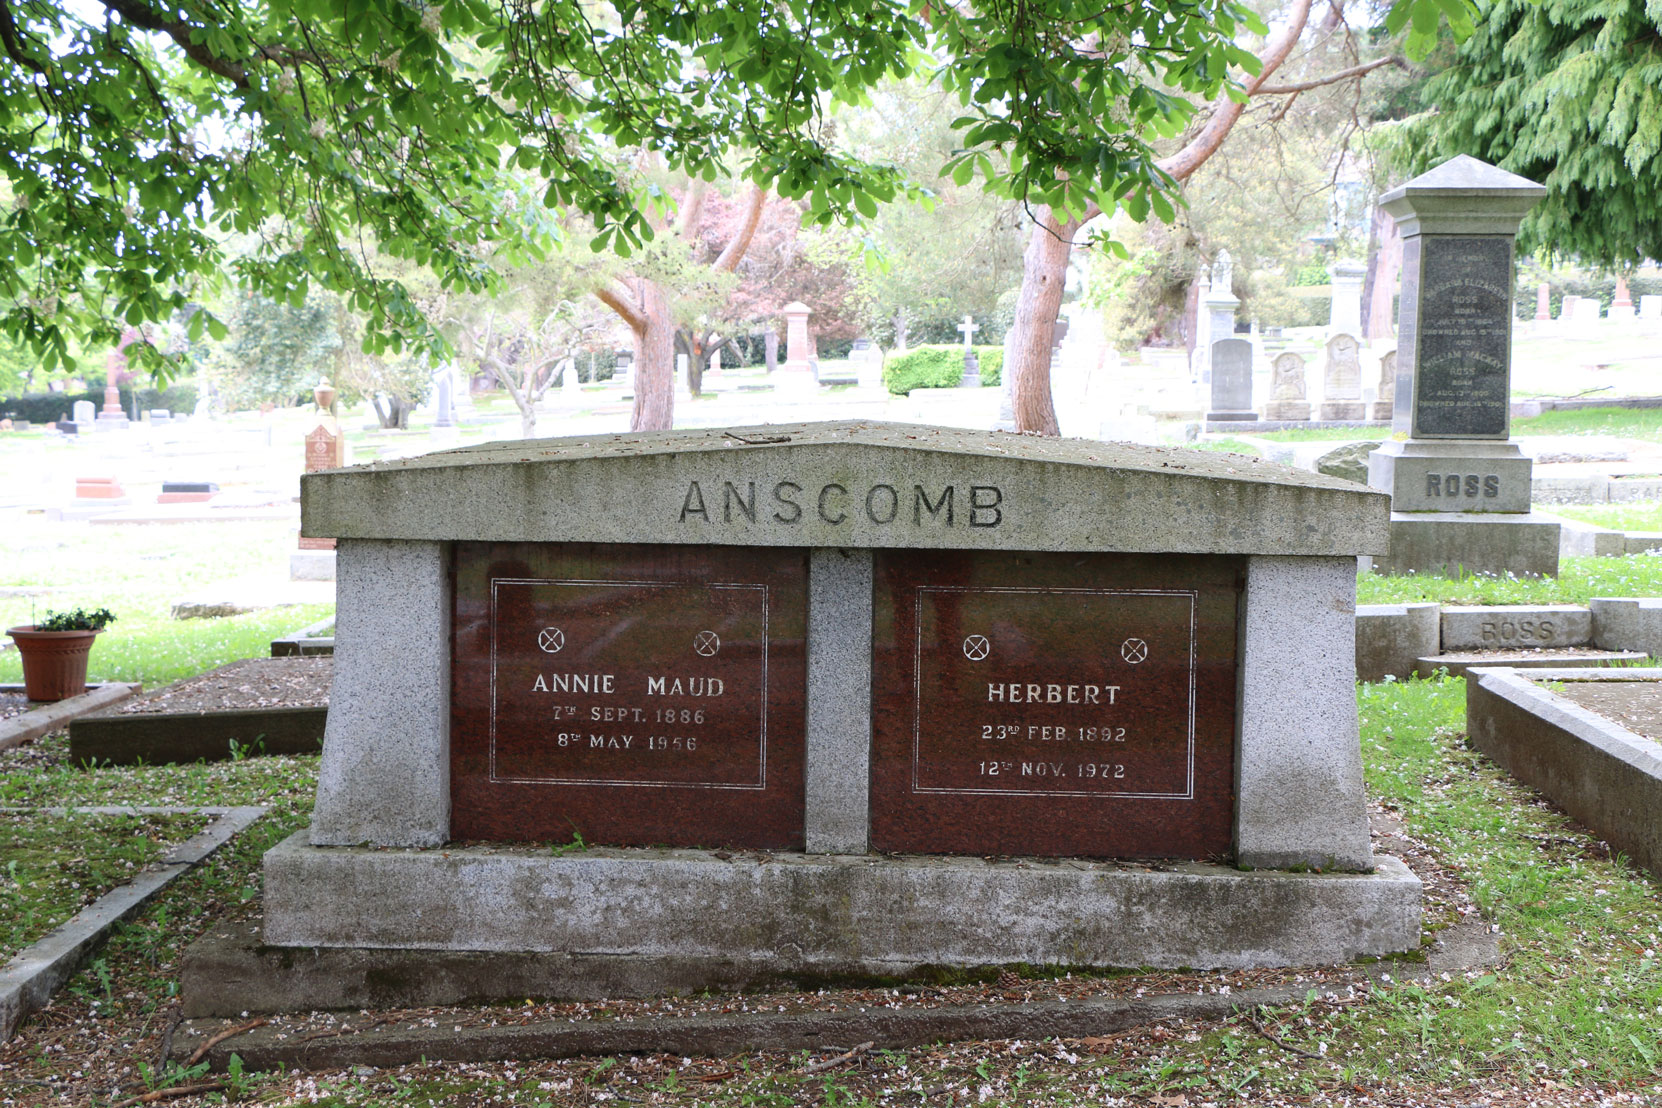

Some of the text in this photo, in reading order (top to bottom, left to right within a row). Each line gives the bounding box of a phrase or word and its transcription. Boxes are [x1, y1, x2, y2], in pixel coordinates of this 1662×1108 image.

[1464, 278, 1507, 300] ELIZABETH
[1452, 296, 1478, 304] ROSS
[1422, 350, 1462, 369] WILLIAM
[1450, 367, 1476, 376] ROSS
[1426, 473, 1499, 498] ROSS
[678, 480, 1004, 529] ANSCOMB
[1481, 620, 1555, 642] ROSS
[532, 673, 724, 697] ANNIE MAUD
[988, 683, 1121, 705] HERBERT
[591, 706, 647, 723] SEPT.
[656, 708, 705, 724] 1886
[590, 734, 634, 749] MAY
[649, 736, 697, 751] 1956
[1078, 727, 1126, 742] 1892
[1022, 762, 1066, 777] NOV.
[1078, 763, 1125, 779] 1972
